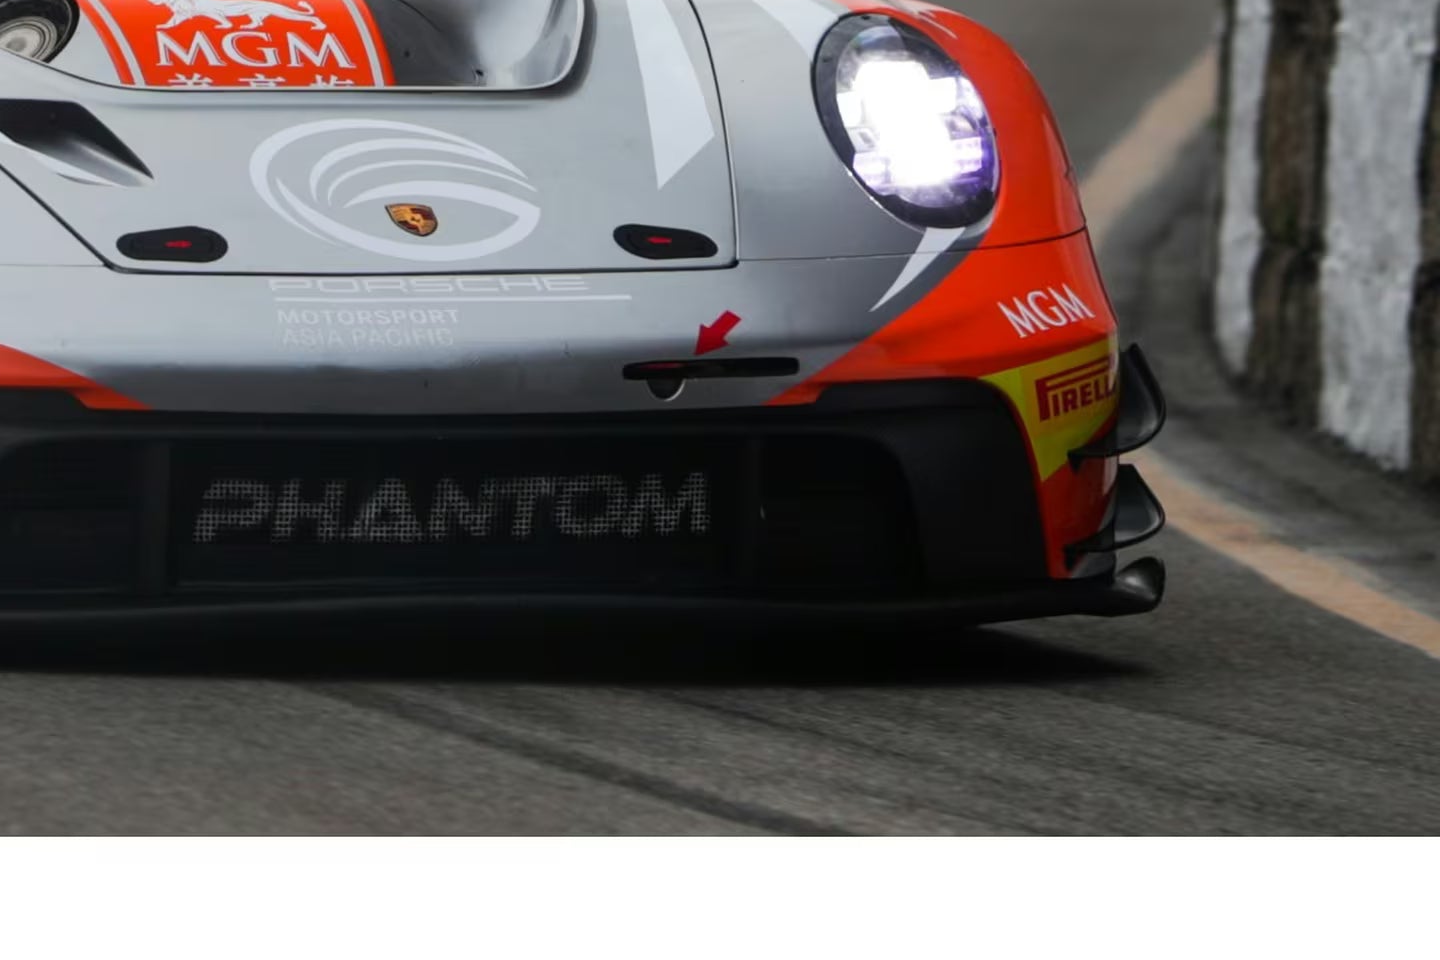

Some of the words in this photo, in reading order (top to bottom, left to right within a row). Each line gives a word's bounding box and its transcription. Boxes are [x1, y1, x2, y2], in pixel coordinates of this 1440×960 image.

[155, 31, 356, 68] MGM
[268, 276, 590, 292] PORSCHE
[276, 308, 460, 326] MOTORSPORT
[997, 282, 1096, 339] MGM
[282, 327, 344, 346] ASIA
[351, 327, 455, 346] PACIFIC
[193, 472, 711, 542] PHANTOM
